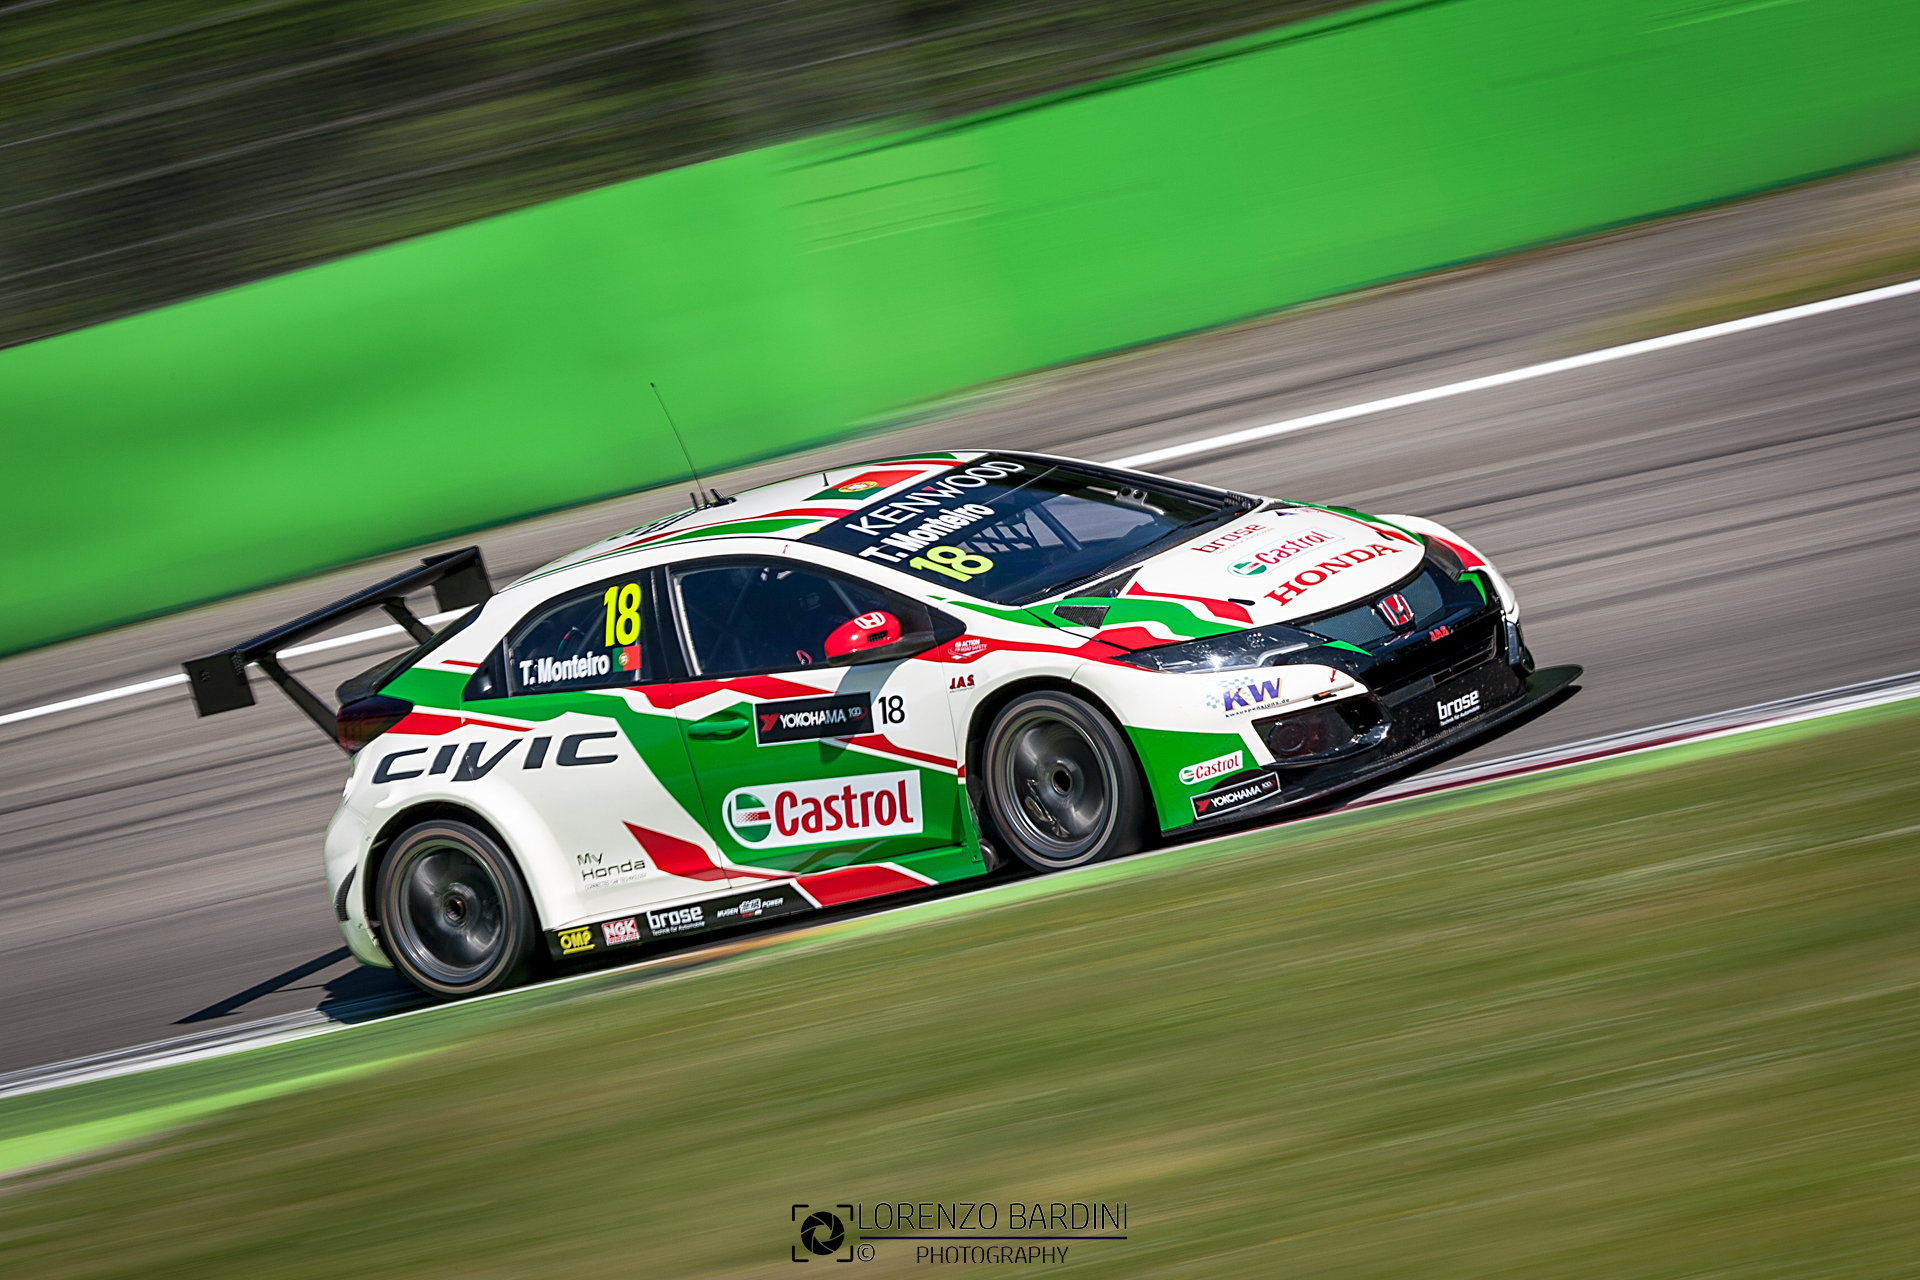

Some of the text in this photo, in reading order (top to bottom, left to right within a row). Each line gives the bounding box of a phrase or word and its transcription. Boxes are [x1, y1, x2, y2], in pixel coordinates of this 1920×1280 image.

[845, 461, 1025, 536] KENWOOD
[880, 503, 995, 552] Monteiro
[1190, 524, 1266, 553] brose
[1255, 531, 1334, 565] Castrol
[909, 545, 994, 582] 18
[1264, 543, 1402, 606] HONDA
[603, 583, 642, 647] 18
[1223, 677, 1282, 711] KW
[1437, 690, 1480, 720] brose
[780, 708, 846, 729] YOKOHAMA
[878, 695, 906, 725] 18
[372, 730, 619, 784] CIVIC
[1196, 754, 1240, 779] Castrol
[774, 779, 914, 836] Castrol
[1210, 785, 1262, 808] YOKOHAMA
[577, 852, 603, 866] My
[581, 859, 646, 881] Honda
[646, 906, 704, 930] brose
[762, 897, 784, 909] POWER
[560, 930, 592, 949] OMP
[603, 920, 636, 938] NGK
